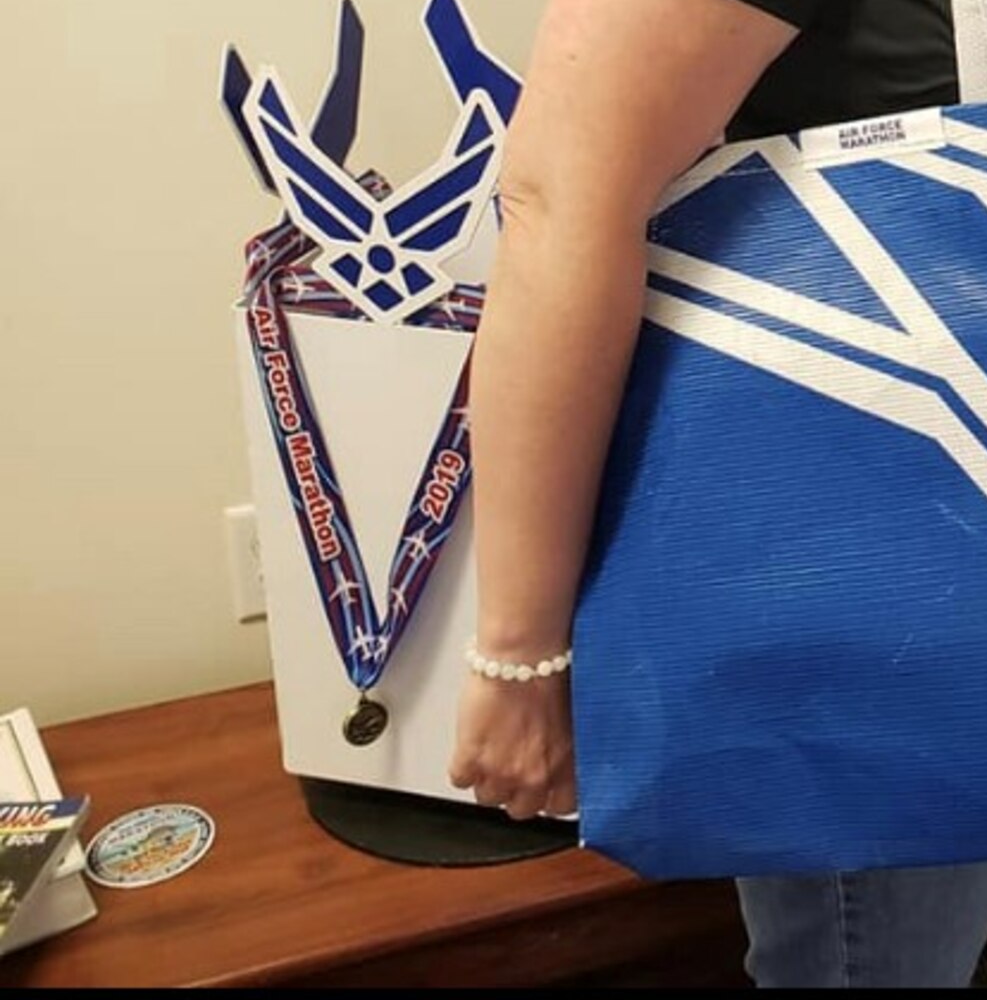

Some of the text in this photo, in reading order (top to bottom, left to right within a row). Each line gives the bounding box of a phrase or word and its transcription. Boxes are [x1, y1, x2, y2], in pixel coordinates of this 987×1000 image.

[839, 120, 902, 139] AIR FORCE
[840, 132, 906, 148] MARATHON
[253, 307, 341, 560] Air Force Marathon
[421, 450, 466, 524] 2019
